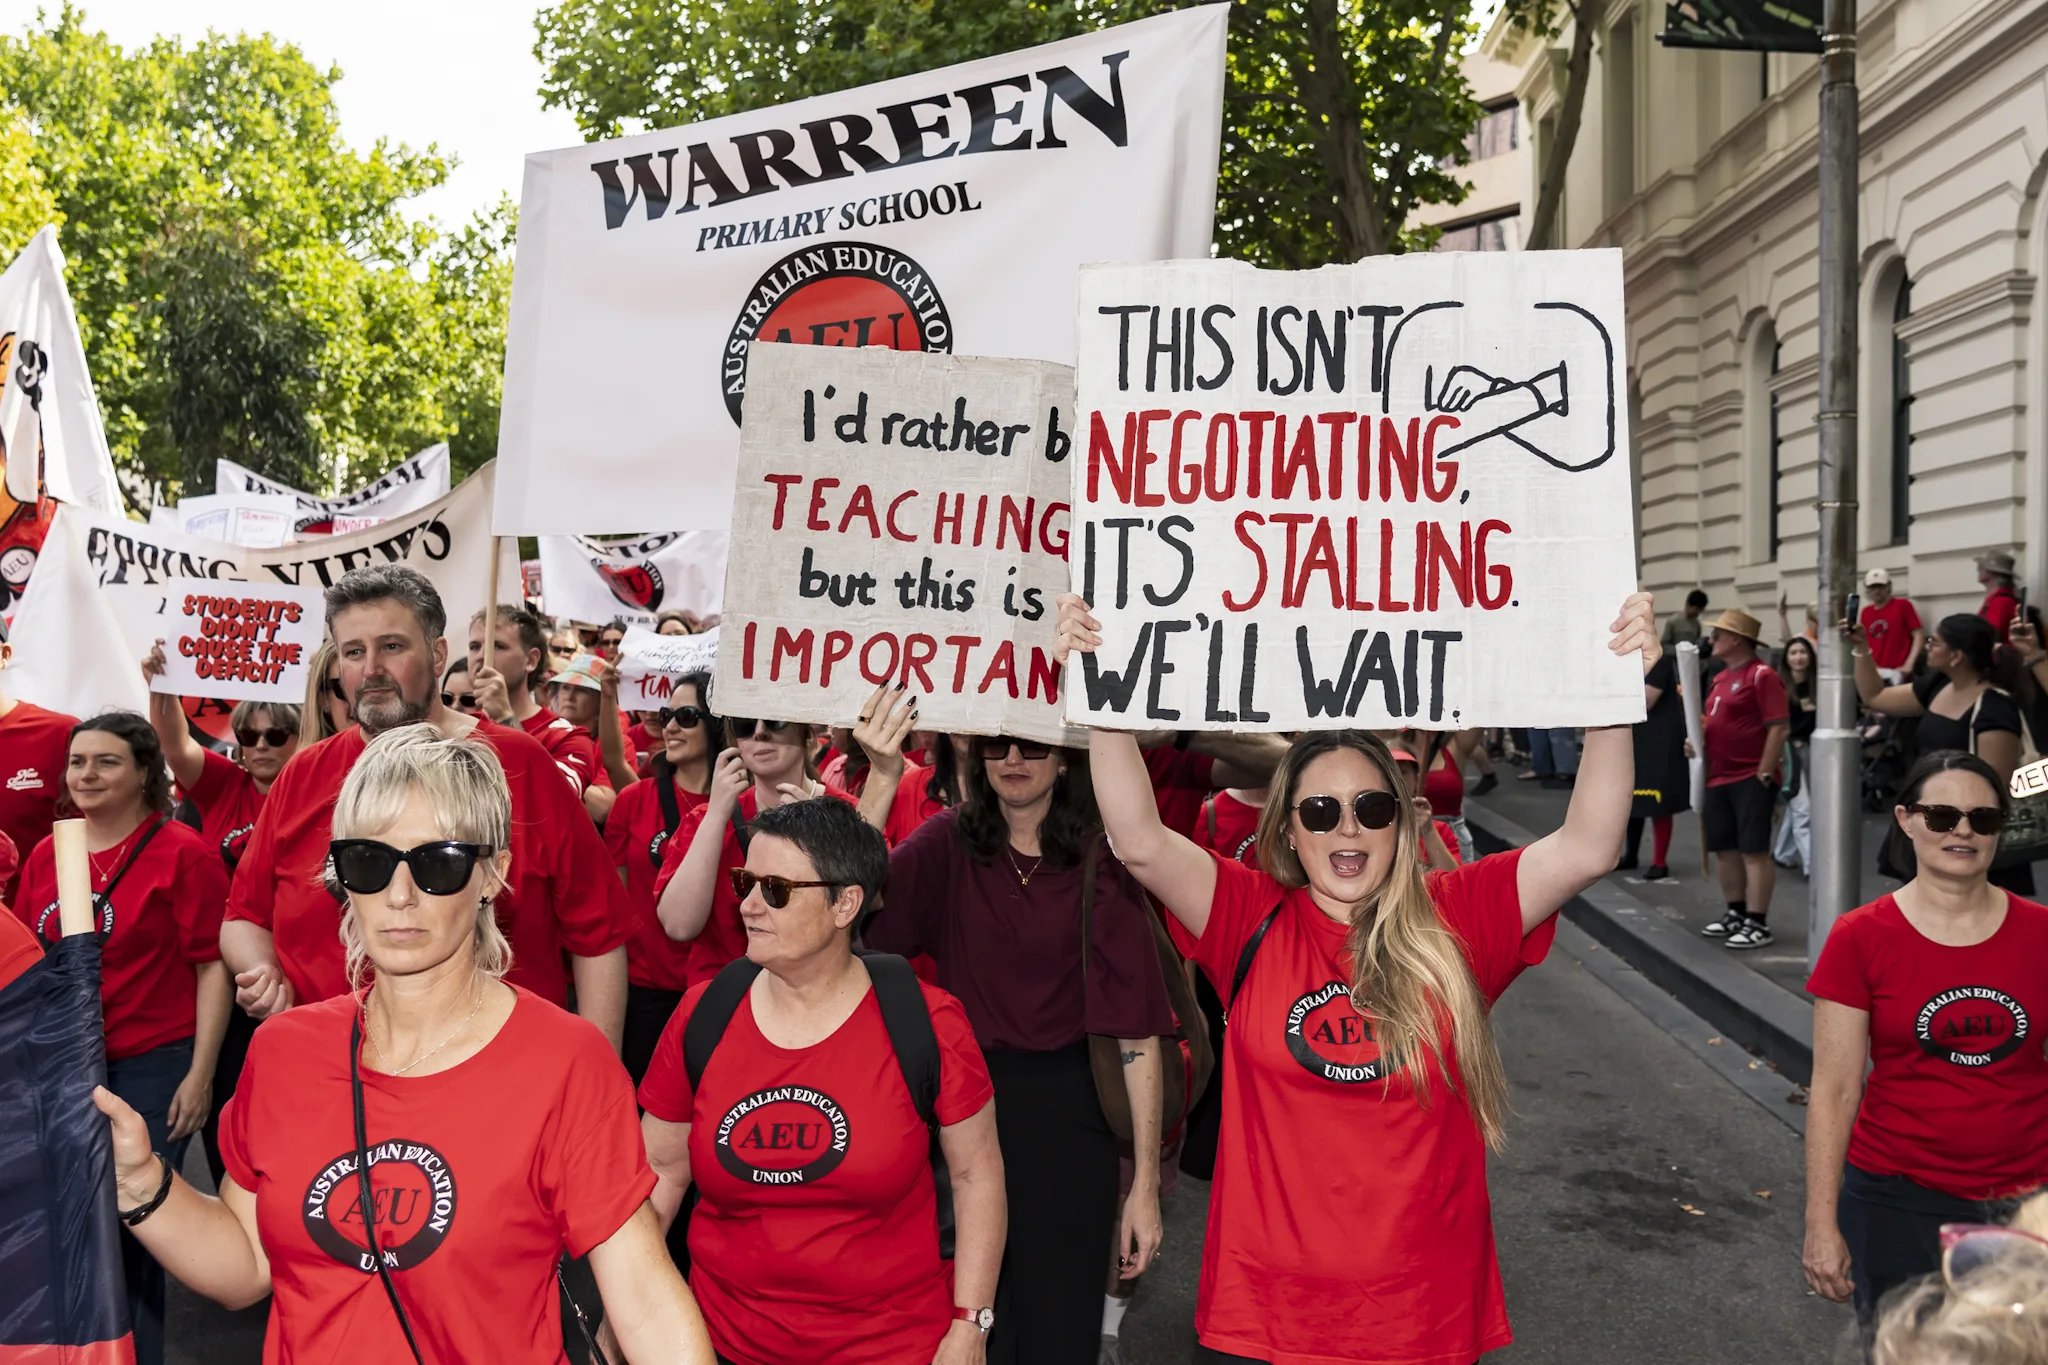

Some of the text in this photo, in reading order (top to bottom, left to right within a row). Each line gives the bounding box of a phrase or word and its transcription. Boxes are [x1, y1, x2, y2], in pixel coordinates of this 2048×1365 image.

[591, 50, 1129, 230] WARREEN
[696, 180, 982, 252] PRIMARY SCHOOL
[725, 248, 829, 396] AUSTRALIAN
[1099, 304, 1404, 396] THIS ISN'T
[803, 384, 1071, 462] I'd rather b
[764, 474, 1071, 563] TEACHING
[799, 546, 1045, 621] but this is
[1083, 514, 1195, 610] IT'S
[182, 594, 303, 623] STUDENTS
[200, 617, 281, 642] DIDN'T
[178, 635, 303, 665] CAUSE THE
[195, 657, 285, 684] DEFICIT
[742, 621, 1064, 705] IMPORTAN
[1083, 613, 1270, 722] WE'LL
[1288, 983, 1350, 1036] AUSTRALIAN
[1917, 988, 2028, 1040] AUSTRALIAN EDUCATION
[1324, 1064, 1377, 1081] UNION
[1950, 1052, 1991, 1066] UNION
[718, 1088, 848, 1152] AUSTRALIAN EDUCATION
[738, 1121, 823, 1150] AEU
[402, 1145, 452, 1233] EDUCATION
[753, 1169, 803, 1184] UNION
